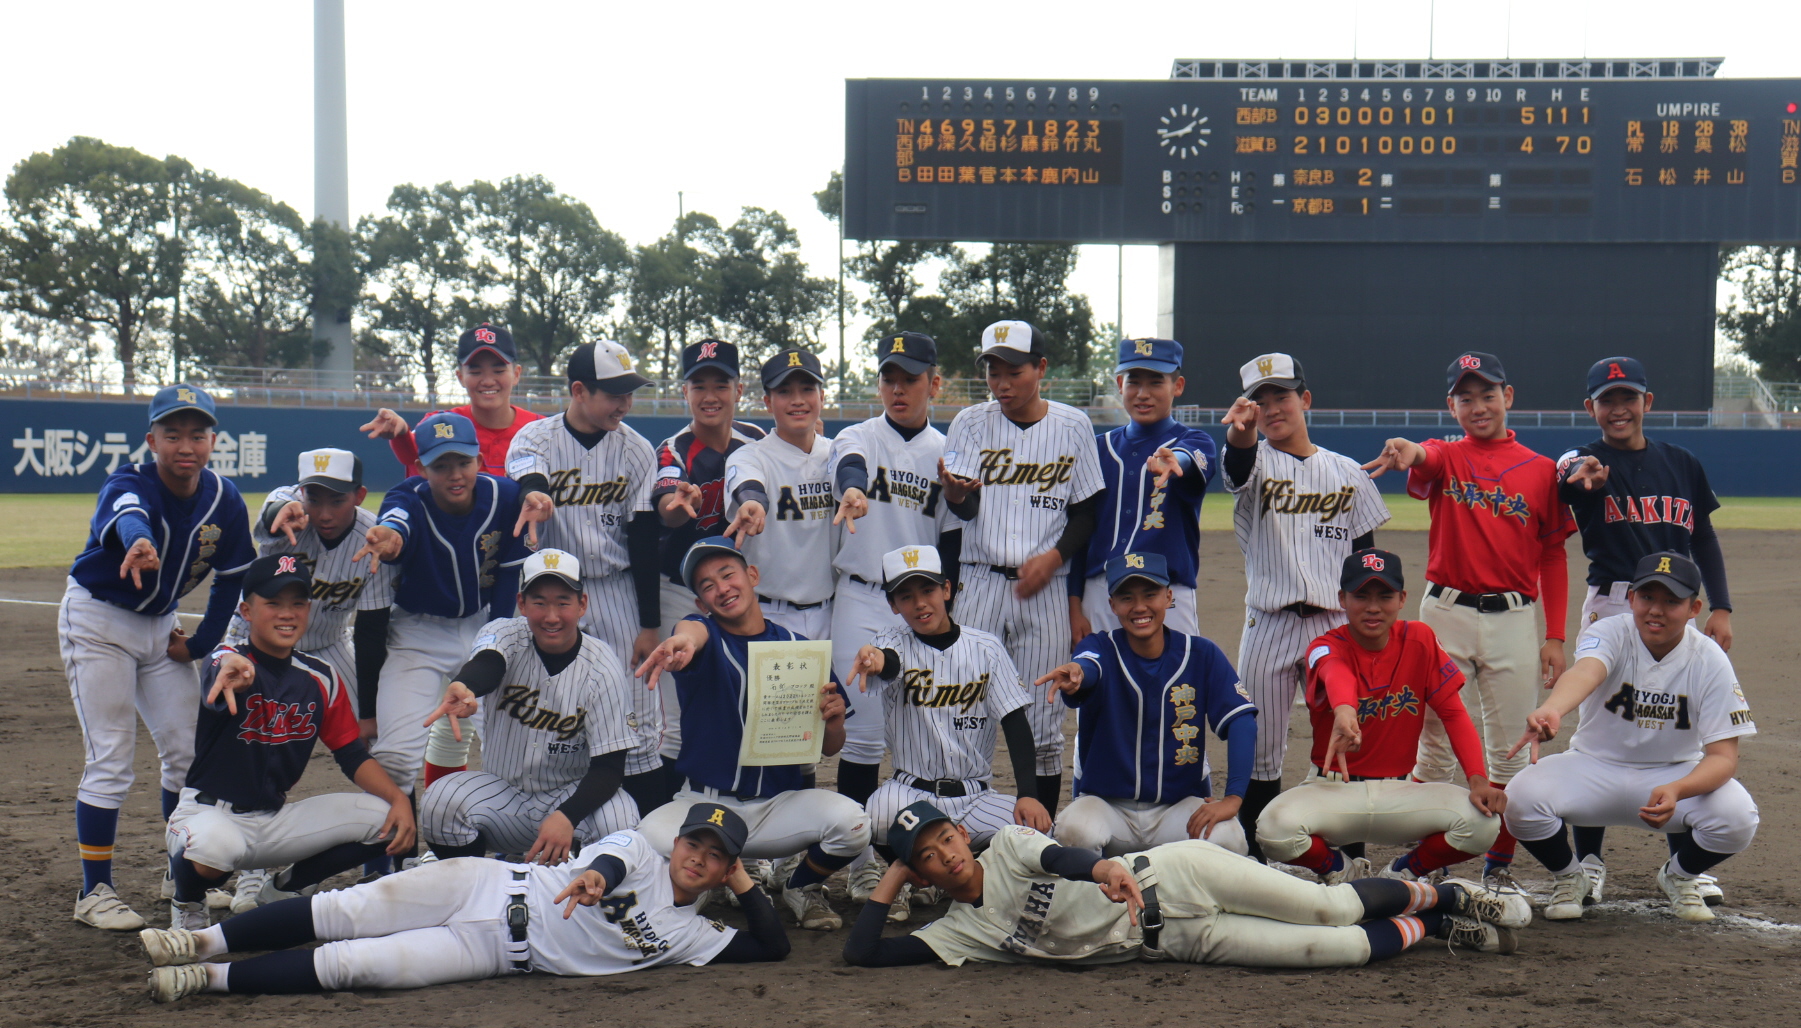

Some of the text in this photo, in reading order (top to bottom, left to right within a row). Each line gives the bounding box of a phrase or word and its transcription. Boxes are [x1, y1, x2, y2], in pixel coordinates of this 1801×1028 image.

[922, 86, 1099, 100] 1 2 3 4 5 6 7 8 9
[1240, 88, 1590, 102] TEAM 1 2 3 4 5 6 7 8 9 10 R H E
[1236, 107, 1588, 124] 西部B 0 3 0 0 0 1 0 1 5 11 1
[1657, 102, 1720, 117] UMPIRE
[920, 120, 932, 135] 4
[941, 120, 954, 135] 6
[962, 120, 974, 135] 9
[983, 120, 995, 135] 5
[1004, 120, 1016, 135] 7
[1028, 120, 1034, 135] 1
[1045, 120, 1058, 135] 8
[1066, 120, 1079, 135] 2
[1087, 120, 1100, 135] 3
[1628, 120, 1748, 136] PL 1B 2B 3B
[1236, 136, 1590, 154] 滋賀B 2 1 0 1 0 0 0 0 4 7 0
[897, 135, 914, 182] 西部B
[917, 135, 934, 182] 伊田
[1000, 135, 1018, 184] 杉本
[1062, 137, 1080, 184] 竹内
[1082, 136, 1101, 183] 丸山
[1727, 136, 1747, 184] 松山
[1162, 170, 1172, 184] B
[1231, 171, 1240, 183] H
[1294, 168, 1372, 186] 奈良B 2
[1163, 186, 1171, 198] S
[1231, 186, 1239, 198] E
[1162, 201, 1172, 214] O
[1292, 198, 1368, 215] 京都B 1
[994, 326, 1010, 343] W
[890, 337, 905, 353] A
[616, 352, 631, 370] W
[788, 352, 802, 366] A
[1256, 358, 1273, 377] W
[1607, 362, 1626, 380] A
[12, 428, 268, 477] 大阪シティ金庫
[314, 455, 331, 472] W
[980, 448, 1074, 492] Himeji
[798, 482, 832, 495] HYOG
[898, 498, 919, 511] WET
[1030, 495, 1064, 512] WEST
[1142, 476, 1168, 530] 戸中央
[1261, 478, 1356, 523] Himeji
[1604, 494, 1694, 535] AAKITA
[1314, 524, 1348, 541] WEST
[902, 550, 919, 568] W
[1125, 554, 1144, 569] KC
[1362, 554, 1384, 571] TC
[1655, 557, 1671, 574] A
[904, 668, 990, 714] Himeji
[1357, 684, 1420, 723] 取中央
[238, 693, 317, 745] Miki
[953, 716, 987, 730] WEST
[1170, 684, 1199, 766] 神戸中央
[707, 808, 726, 826] A
